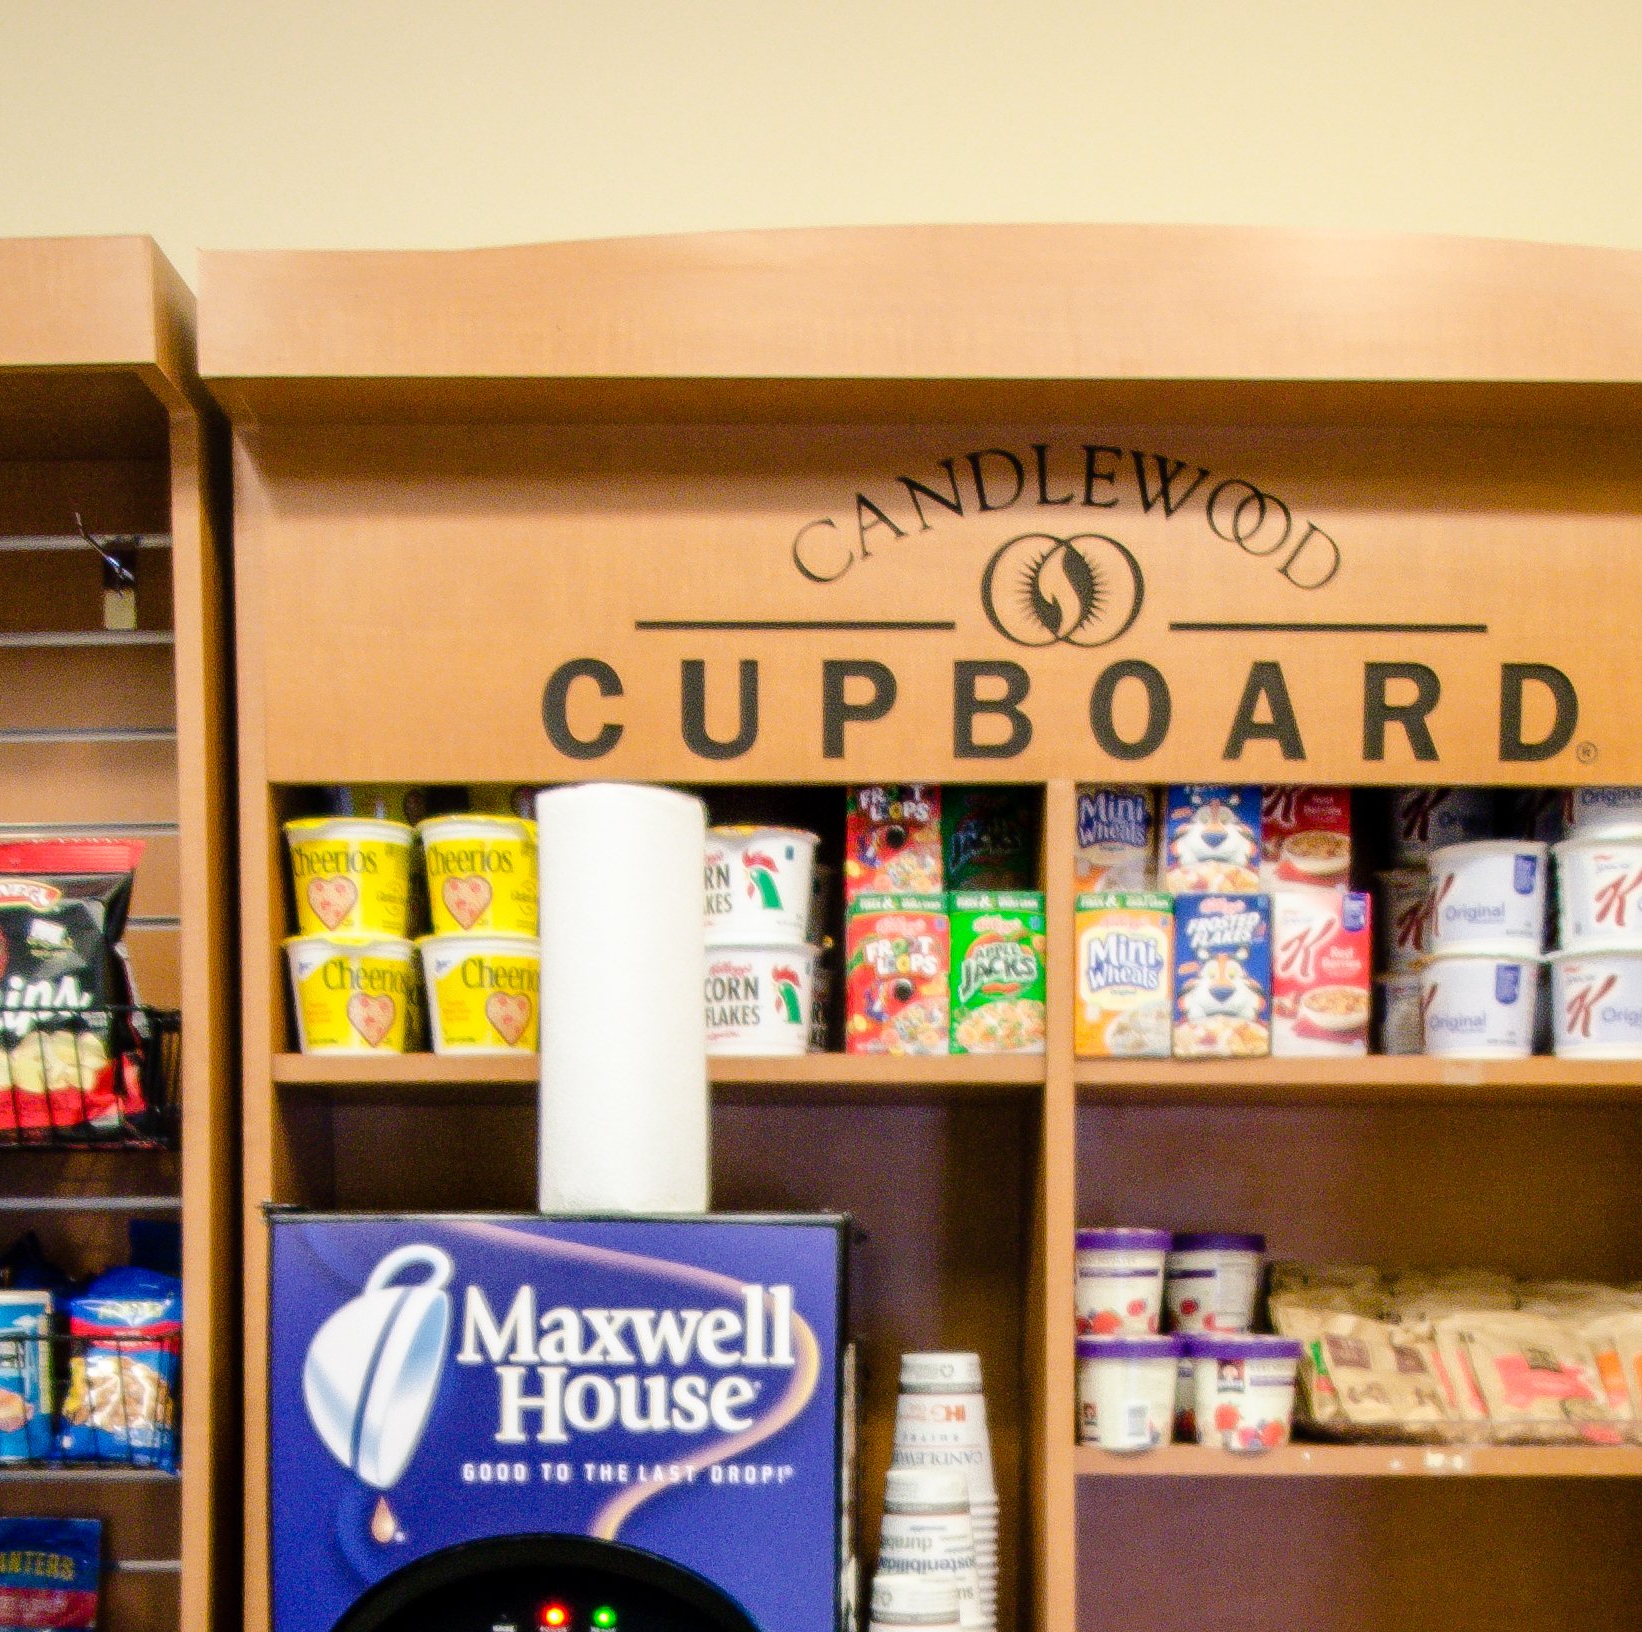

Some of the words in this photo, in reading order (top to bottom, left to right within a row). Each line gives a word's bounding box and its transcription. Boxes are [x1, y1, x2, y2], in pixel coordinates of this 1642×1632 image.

[790, 441, 1343, 592] CANDLEWOOD
[539, 657, 1581, 764] CUPBOARD
[456, 1284, 796, 1368] Maxwell
[494, 1365, 756, 1443] House
[462, 1462, 526, 1484] GOOD
[541, 1462, 570, 1484] TO
[584, 1462, 629, 1485] THE
[637, 1462, 697, 1485] LAST
